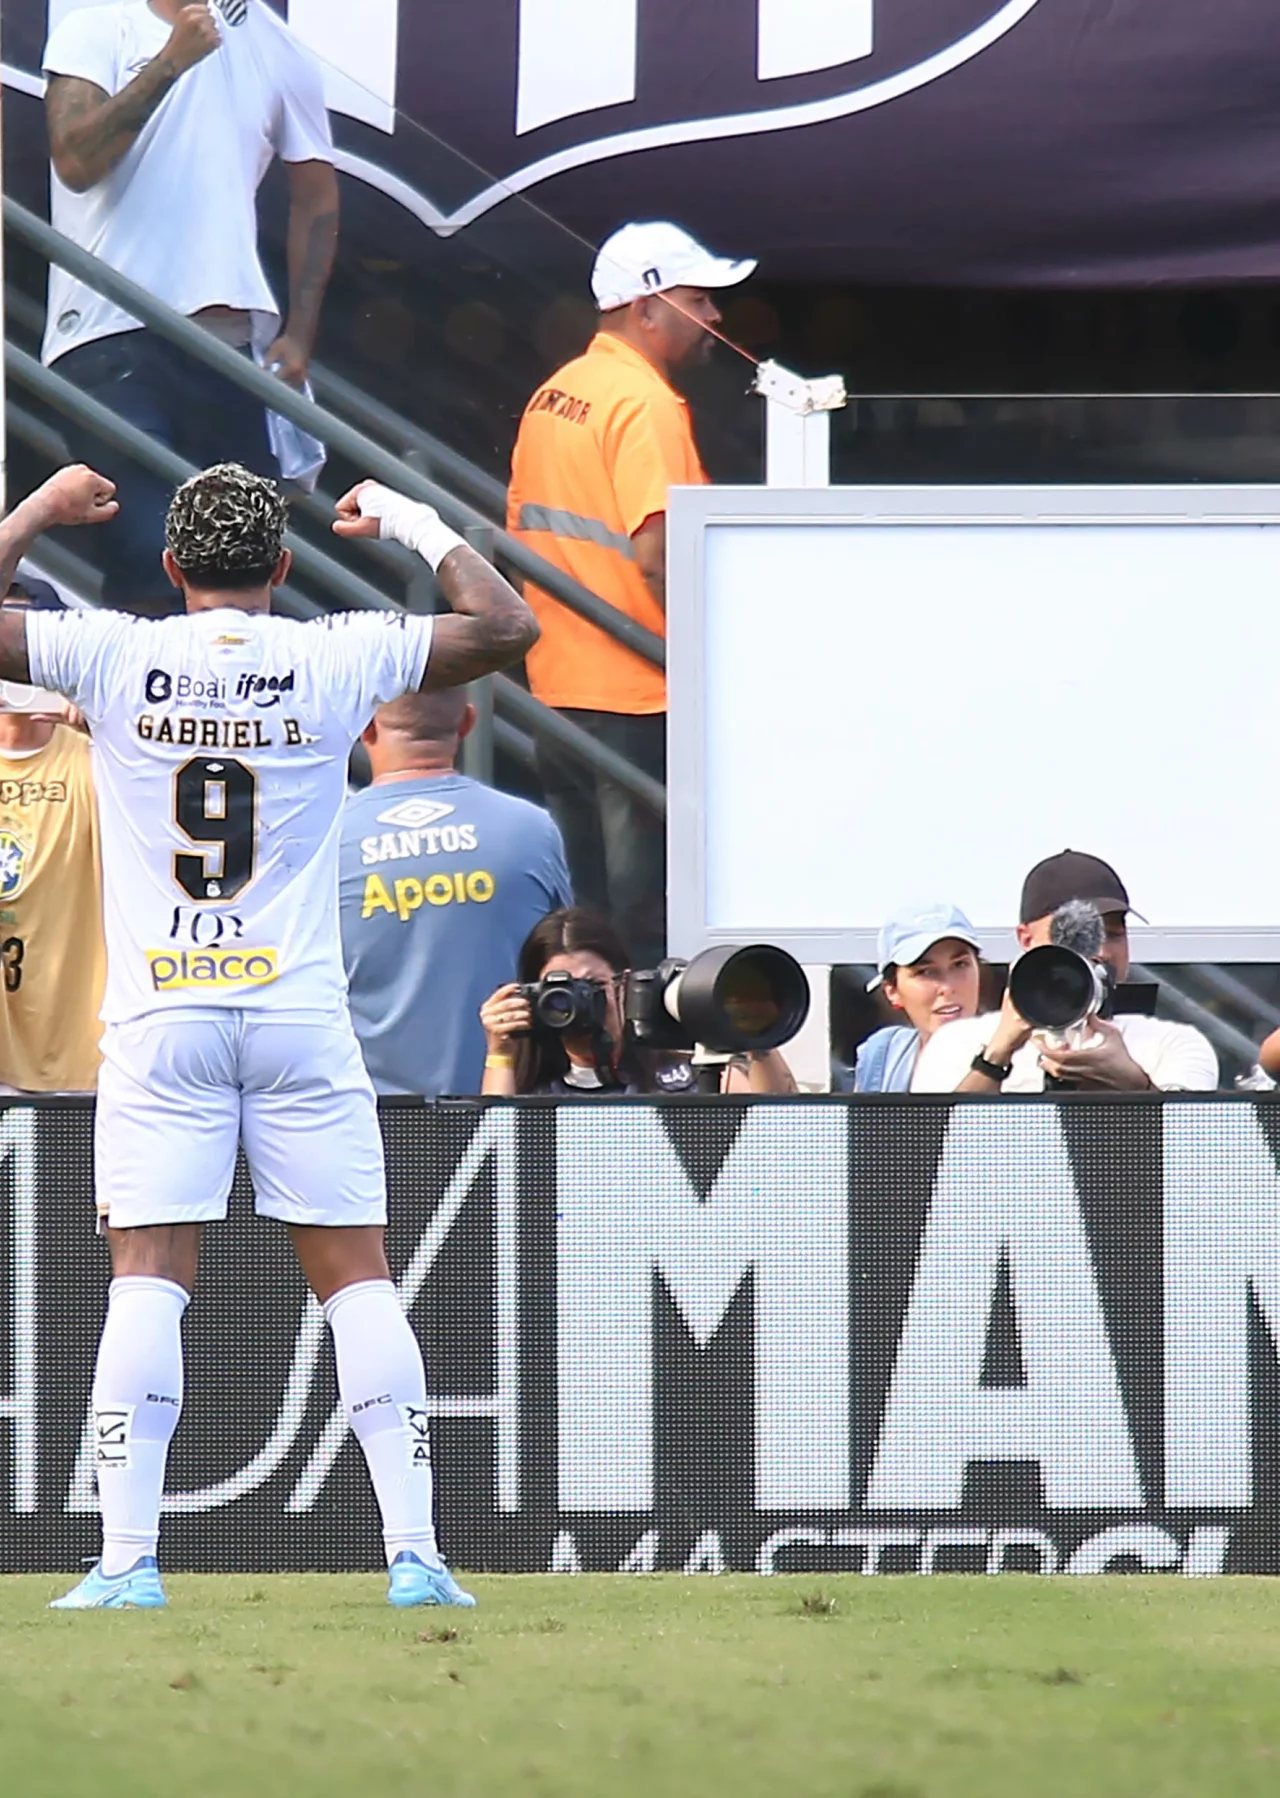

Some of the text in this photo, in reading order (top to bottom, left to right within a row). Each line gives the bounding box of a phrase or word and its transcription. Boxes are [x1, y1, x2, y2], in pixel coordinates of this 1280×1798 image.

[137, 714, 312, 748] GABRIEL B.
[172, 756, 259, 904] 9
[360, 824, 478, 865] SANTOS
[361, 870, 495, 921] Apoio
[150, 950, 273, 992] placo
